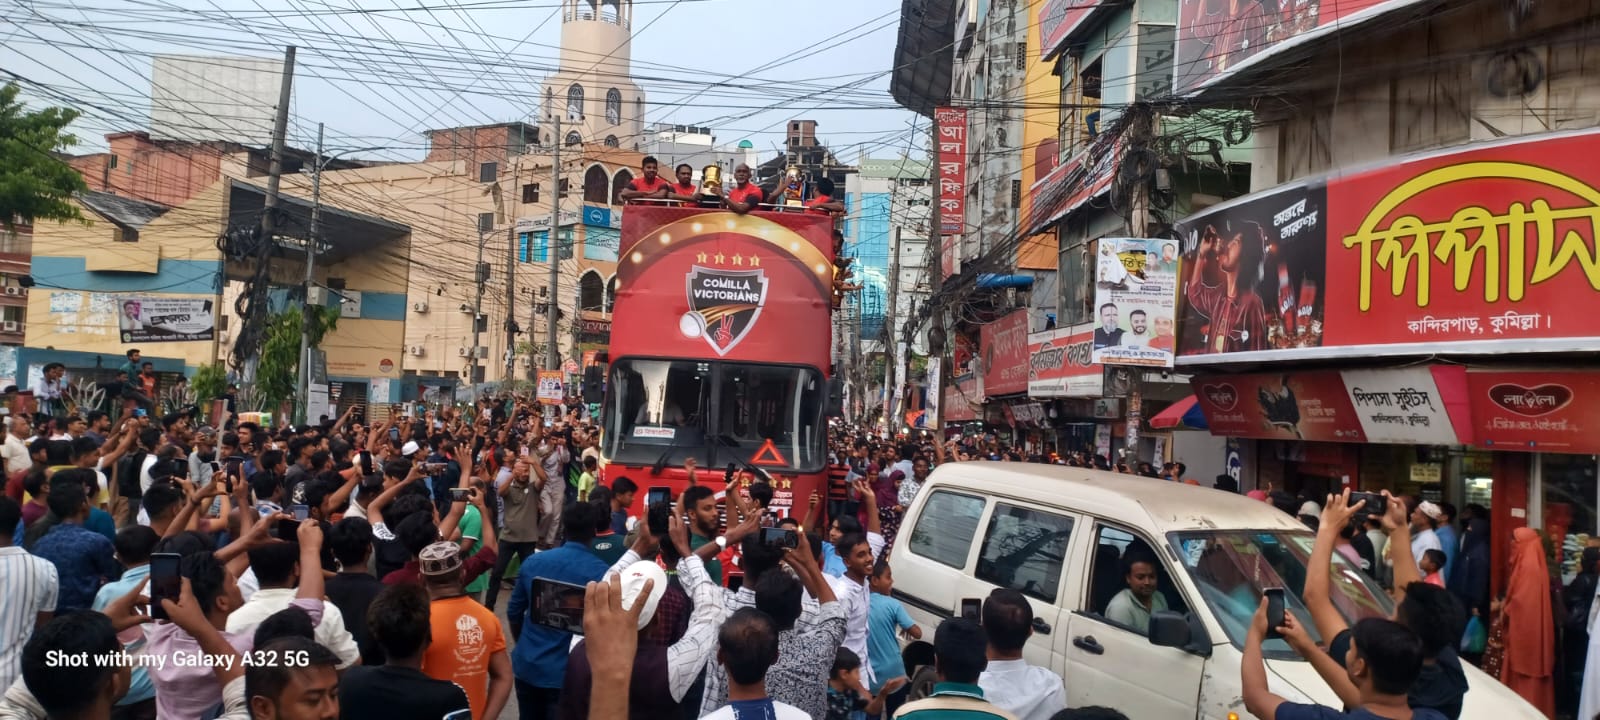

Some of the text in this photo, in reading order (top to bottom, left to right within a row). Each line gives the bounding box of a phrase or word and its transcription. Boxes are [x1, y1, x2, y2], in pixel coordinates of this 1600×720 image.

[703, 277, 751, 290] COMILLA
[694, 288, 760, 303] VICTORIANS
[1352, 387, 1392, 407] পিপাসা
